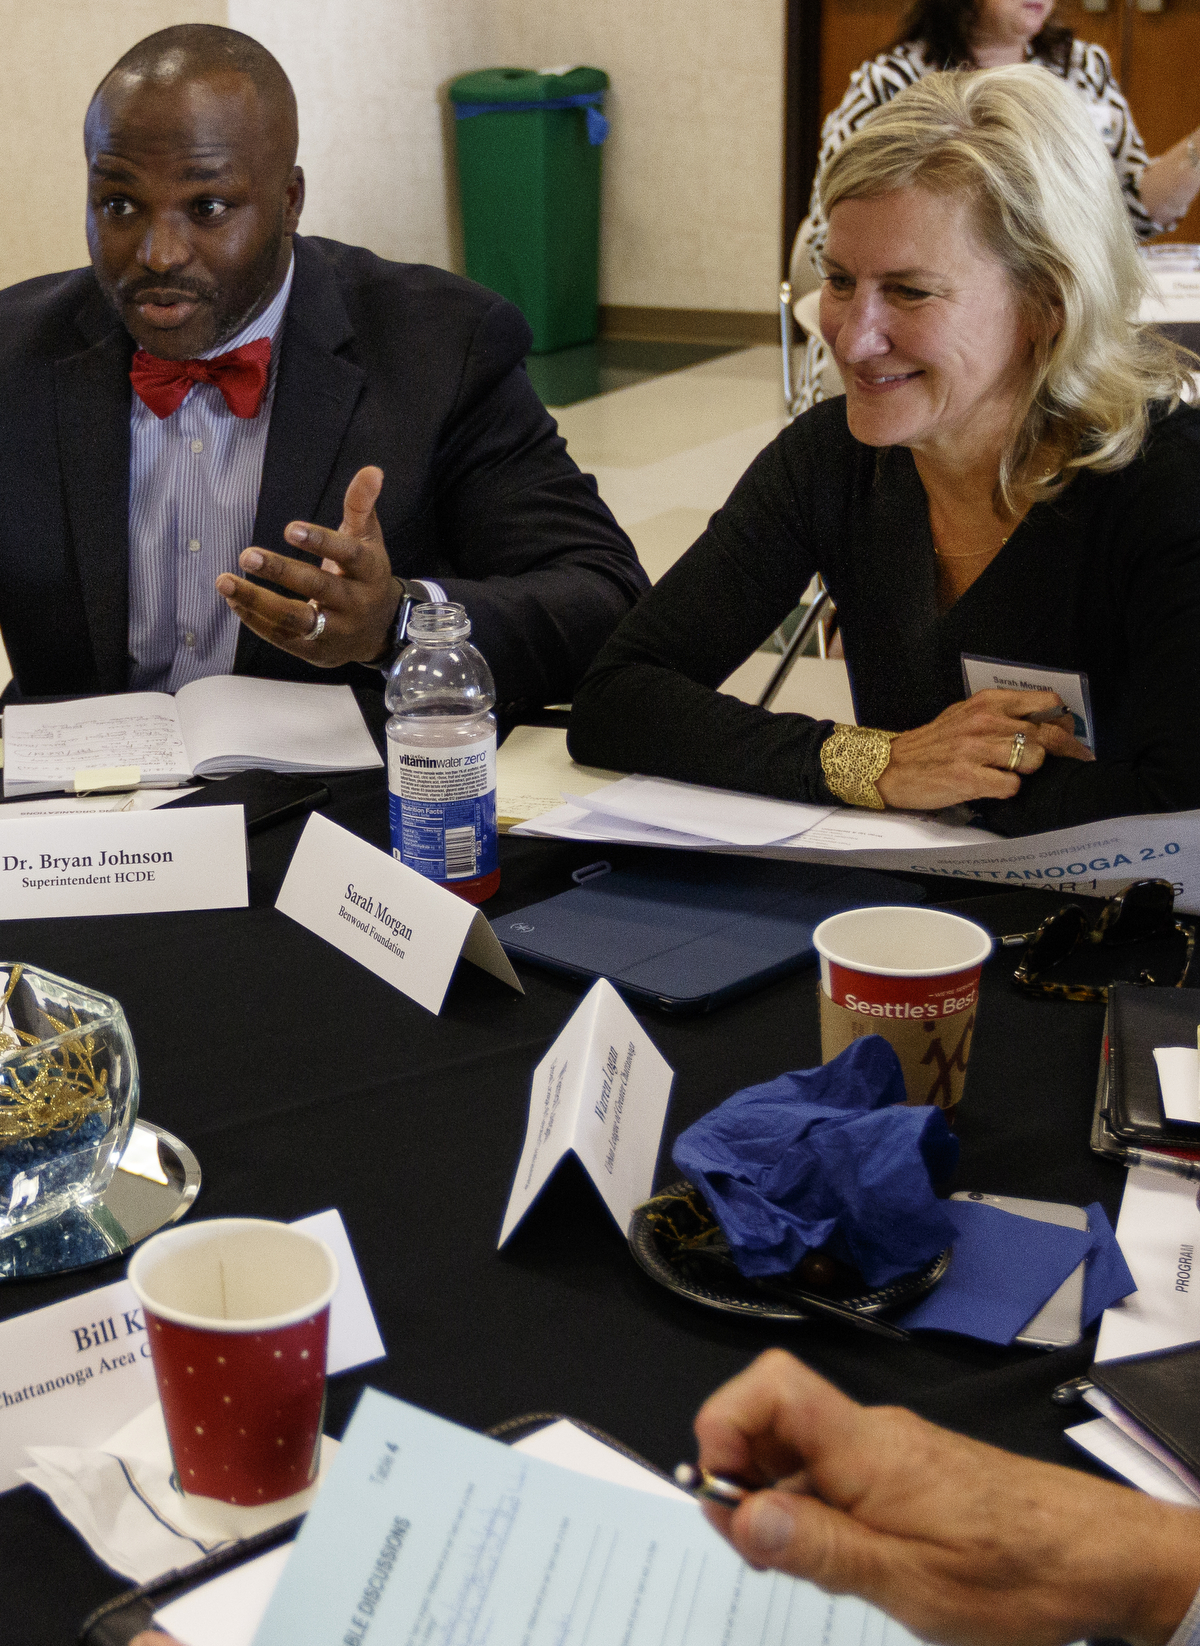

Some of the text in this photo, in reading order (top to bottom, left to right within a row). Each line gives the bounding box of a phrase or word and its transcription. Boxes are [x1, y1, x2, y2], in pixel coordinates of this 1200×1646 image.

[993, 676, 1018, 687] Sarah
[1020, 681, 1053, 692] Morgan
[399, 751, 486, 768] vitaminwater zero
[425, 807, 443, 815] Facts
[2, 847, 174, 872] Dr. Bryan Johnson
[910, 842, 1181, 881] CHATTANOOGA 2.0
[22, 870, 156, 890] Superintendent HCDE
[1089, 878, 1097, 890] 1
[344, 883, 413, 941] Sarah Morgan
[338, 905, 406, 959] Benwood Foundation
[844, 988, 977, 1020] Seattle's Best
[594, 1045, 618, 1125] Warren Logan
[1175, 1244, 1194, 1293] PROGRAM
[71, 1308, 148, 1354] Bill K
[99, 1349, 136, 1374] Area
[140, 1342, 152, 1358] C
[343, 1515, 411, 1646] BLE DISCUSSIONS
